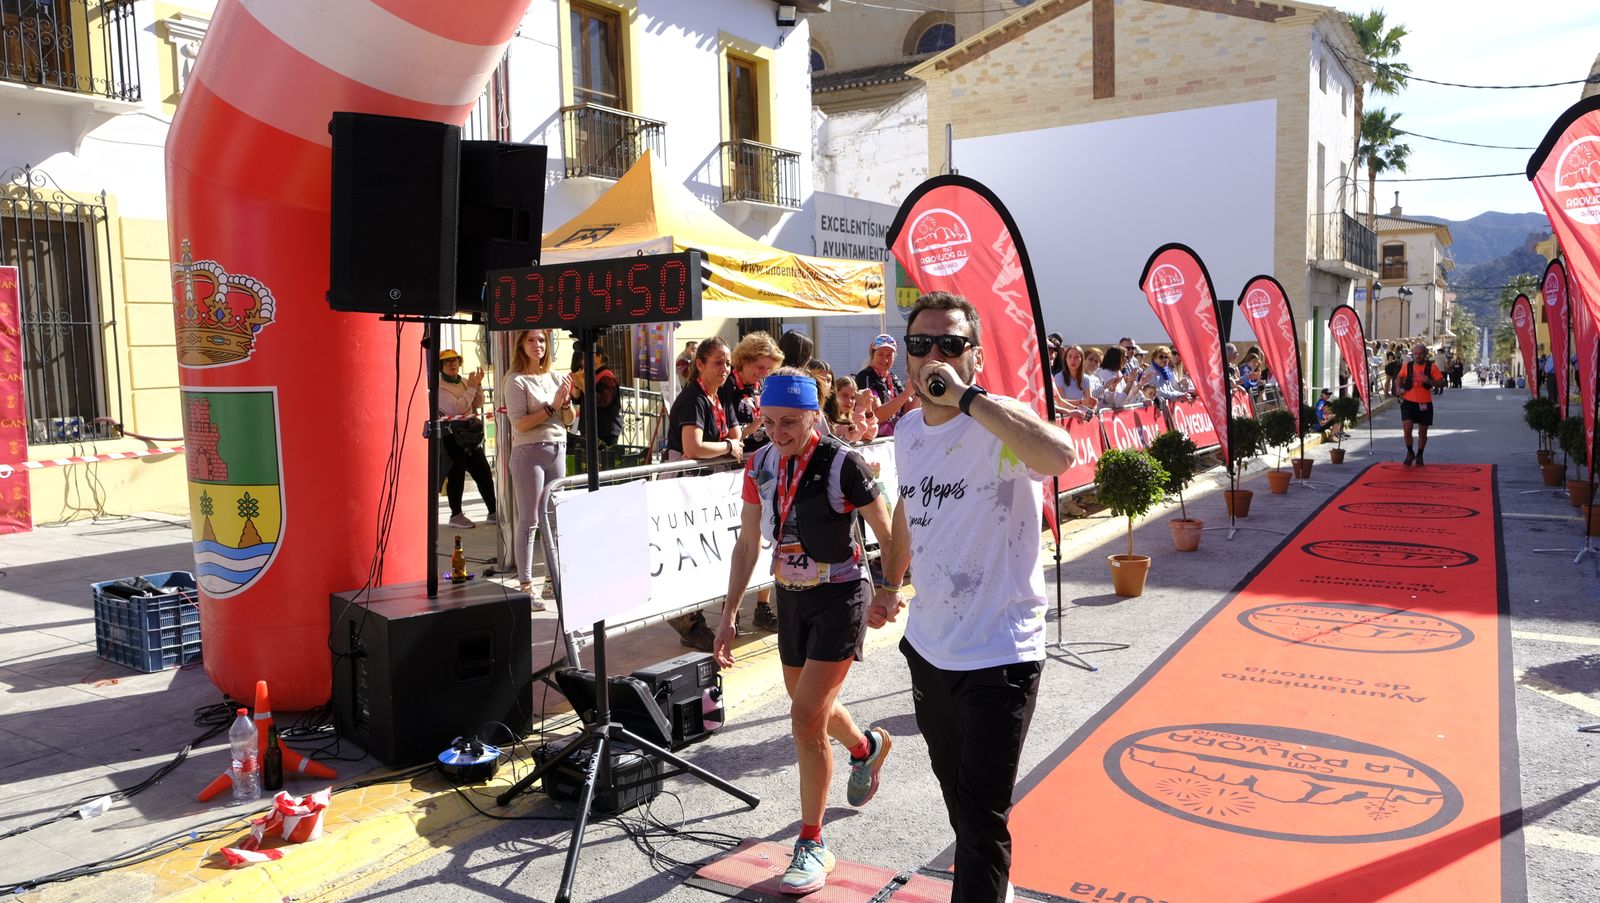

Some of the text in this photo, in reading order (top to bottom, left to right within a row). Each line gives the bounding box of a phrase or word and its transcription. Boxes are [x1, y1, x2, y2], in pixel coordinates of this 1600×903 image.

[823, 241, 889, 262] AYUNTAMIENTO
[494, 260, 686, 324] 03:04:50
[920, 476, 968, 510] Yepes
[1221, 673, 1426, 703] Ayuntamiento
[1245, 666, 1410, 691] de Cantoria
[1192, 729, 1281, 747] Cantoria
[1365, 762, 1415, 778] LA
[1070, 881, 1169, 903] oria
